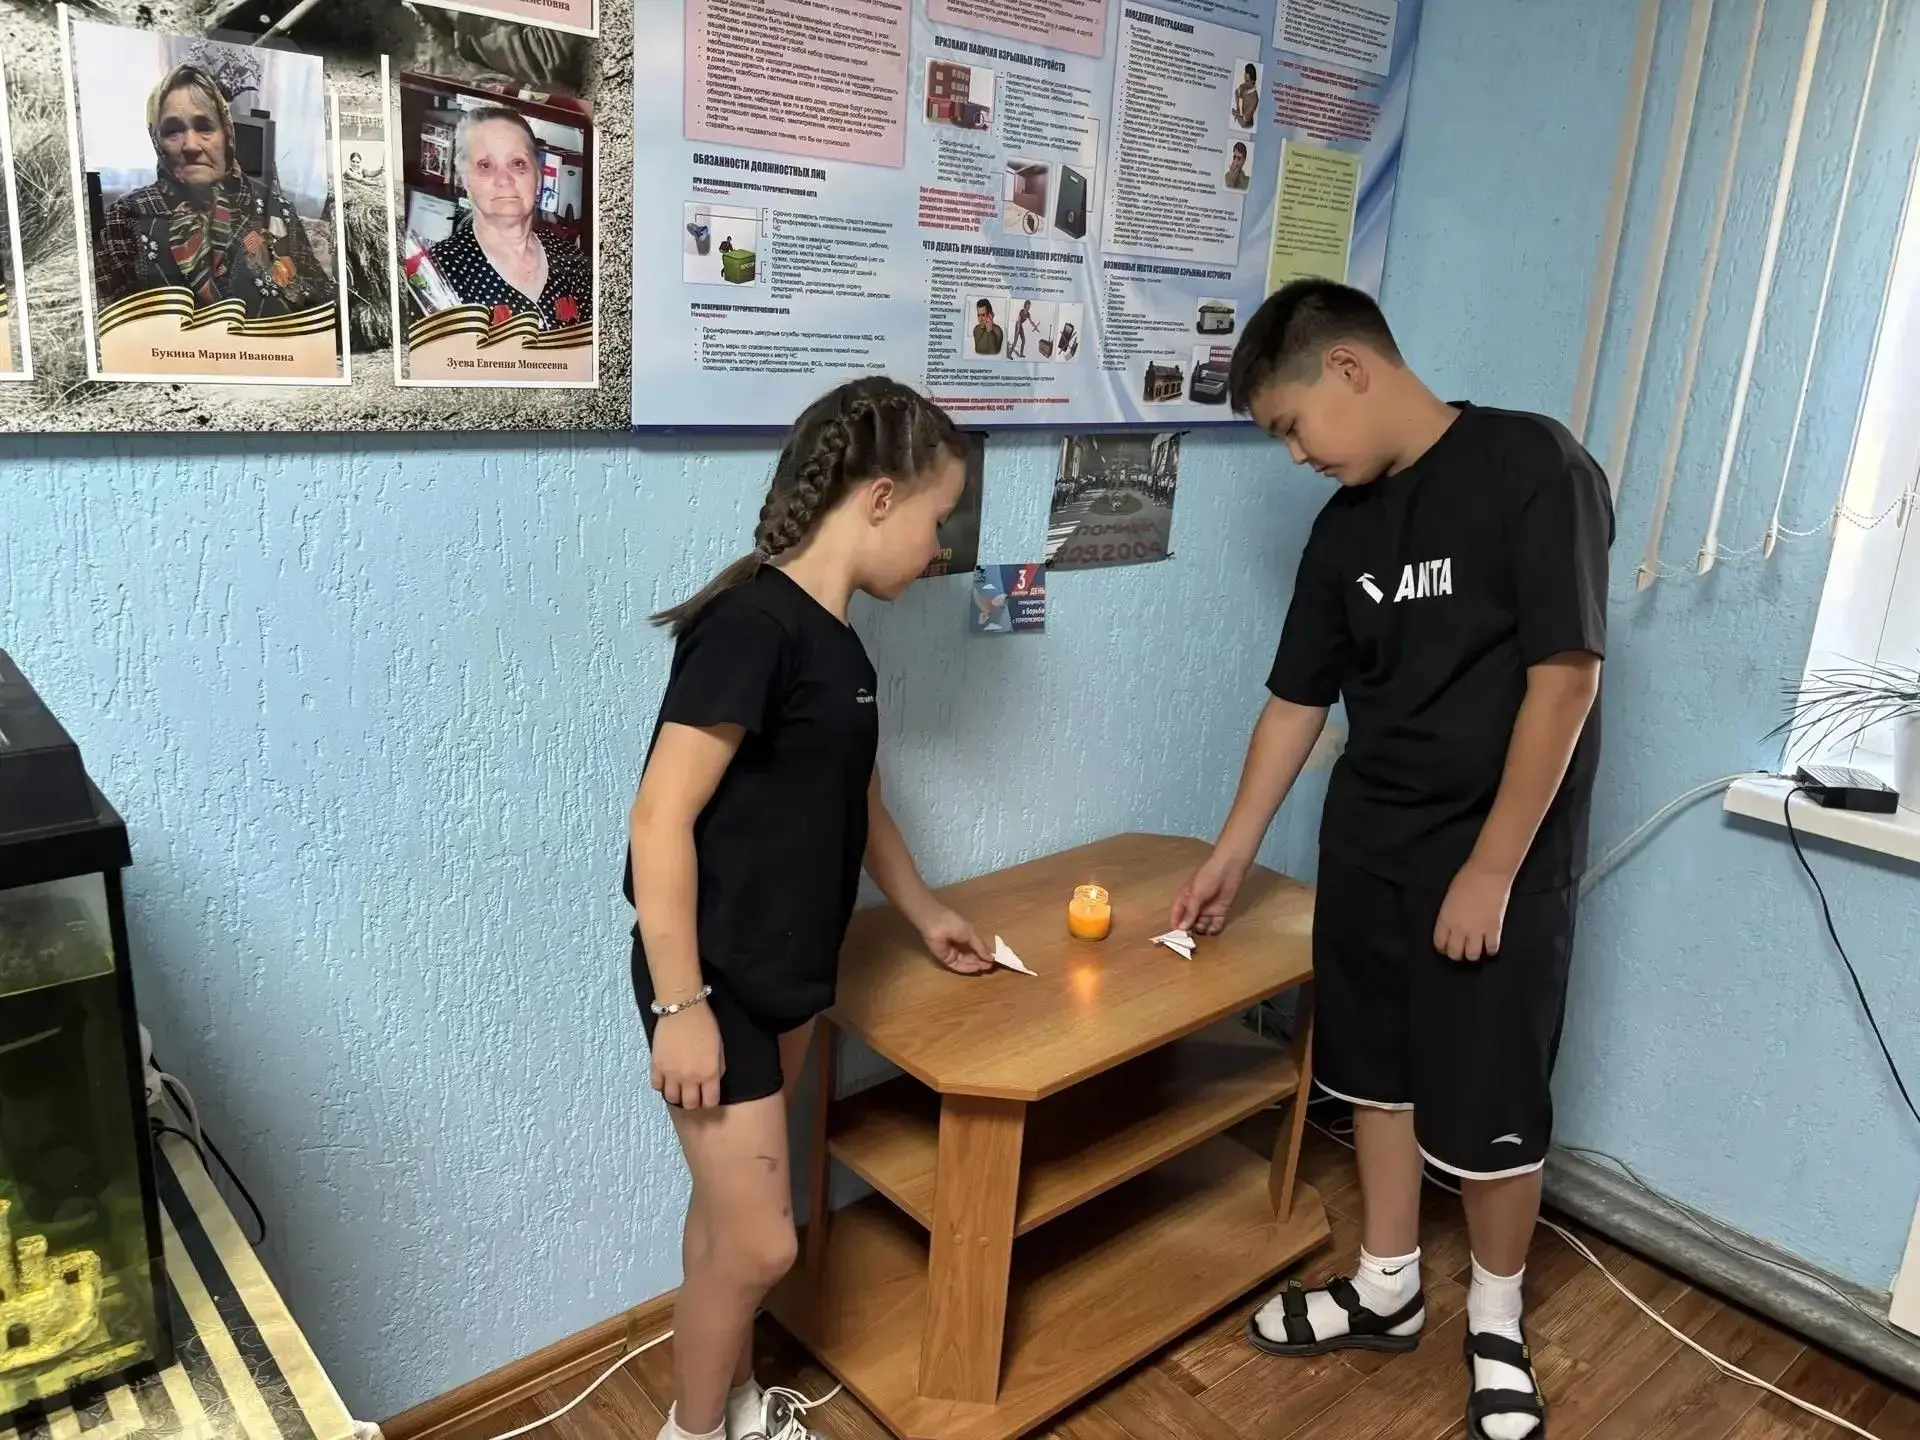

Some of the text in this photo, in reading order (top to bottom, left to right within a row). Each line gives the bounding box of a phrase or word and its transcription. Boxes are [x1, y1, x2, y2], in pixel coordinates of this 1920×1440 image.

[693, 152, 826, 182] ОБЯЗАННОСТИ ДОЛЖНОСТНЫХ ЛИЦ
[152, 348, 294, 362] Букина Мария Ивановна
[447, 358, 568, 370] Зуева Евгения Моисеевна
[1018, 570, 1027, 590] 3
[1394, 558, 1452, 602] ANTA
[1030, 588, 1046, 596] ДЕНЬ
